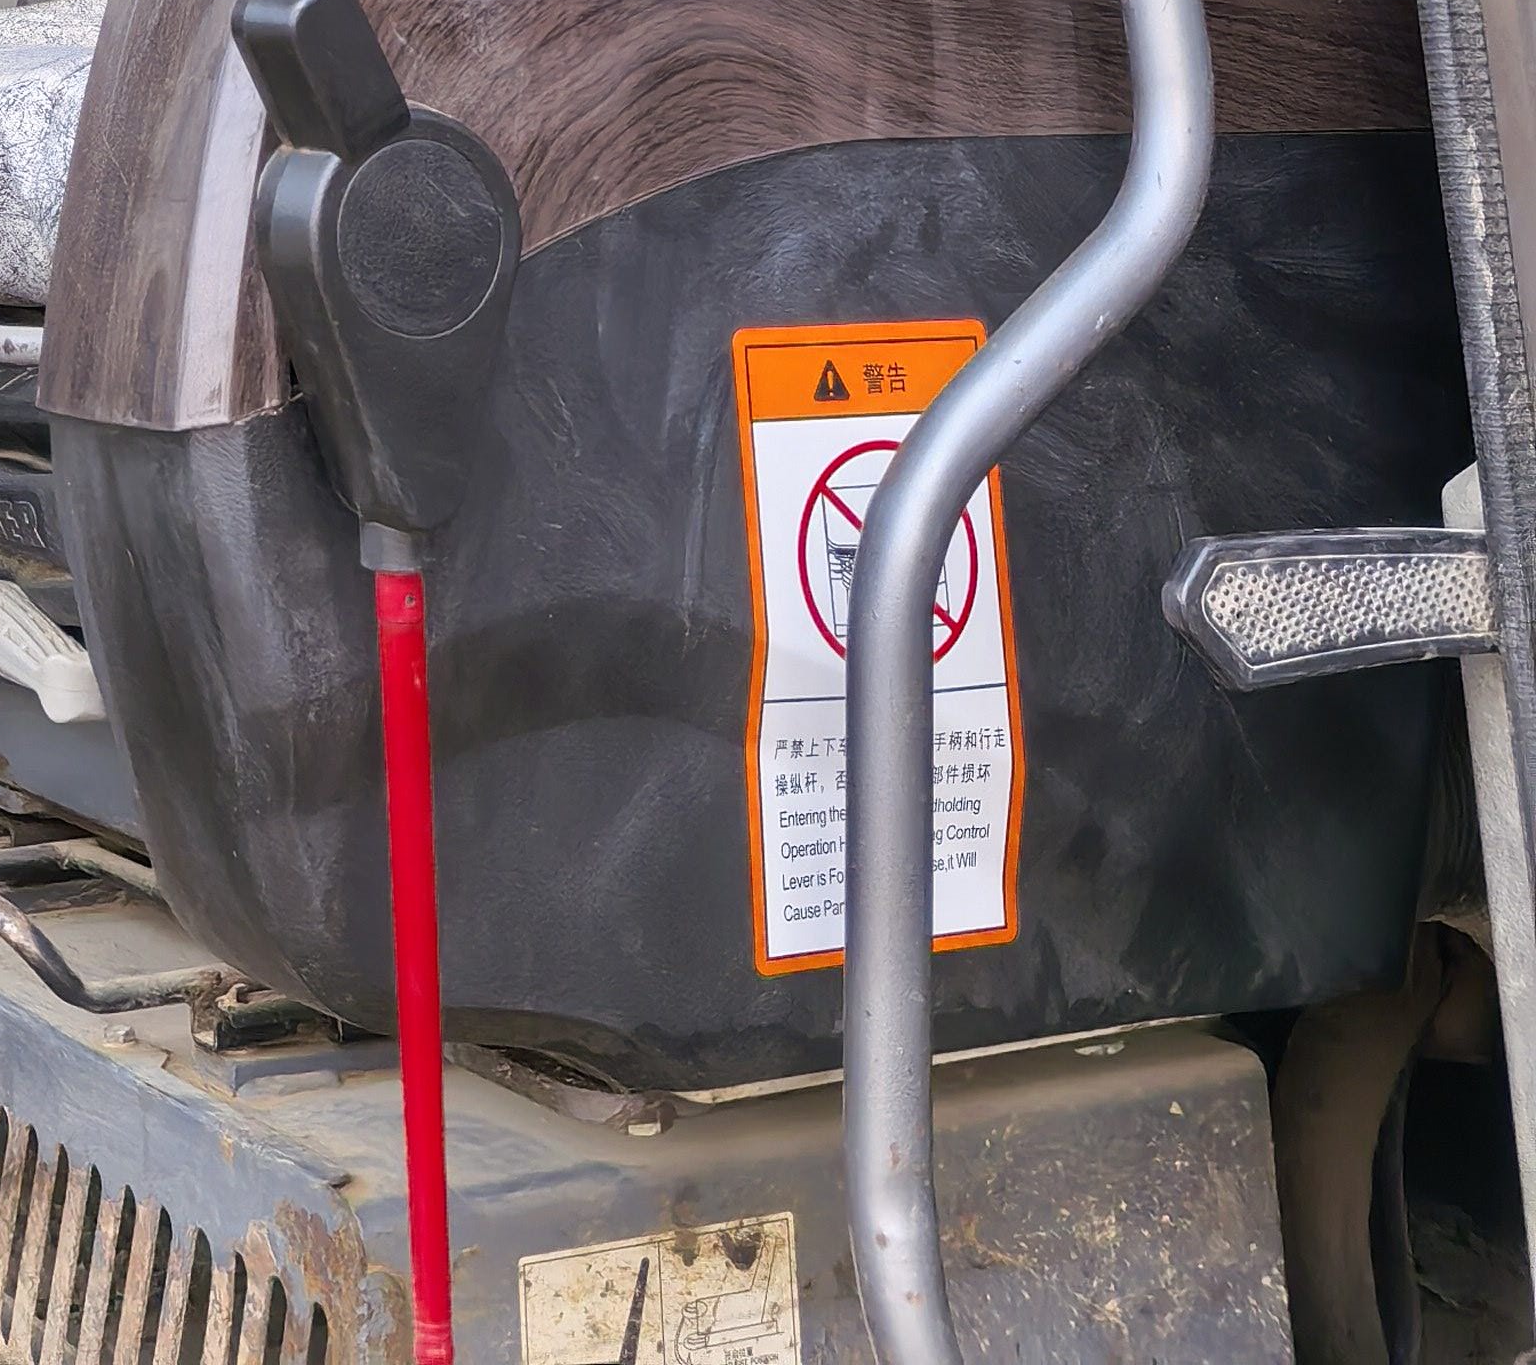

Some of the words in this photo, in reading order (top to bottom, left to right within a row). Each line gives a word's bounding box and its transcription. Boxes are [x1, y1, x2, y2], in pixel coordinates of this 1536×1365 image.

[862, 361, 907, 395] 警告
[779, 810, 827, 829] Entering
[780, 837, 837, 863] Operation
[946, 823, 991, 841] Control
[782, 873, 815, 891] Lever
[816, 871, 827, 887] is
[955, 851, 977, 869] Will
[783, 904, 821, 922] Cause
